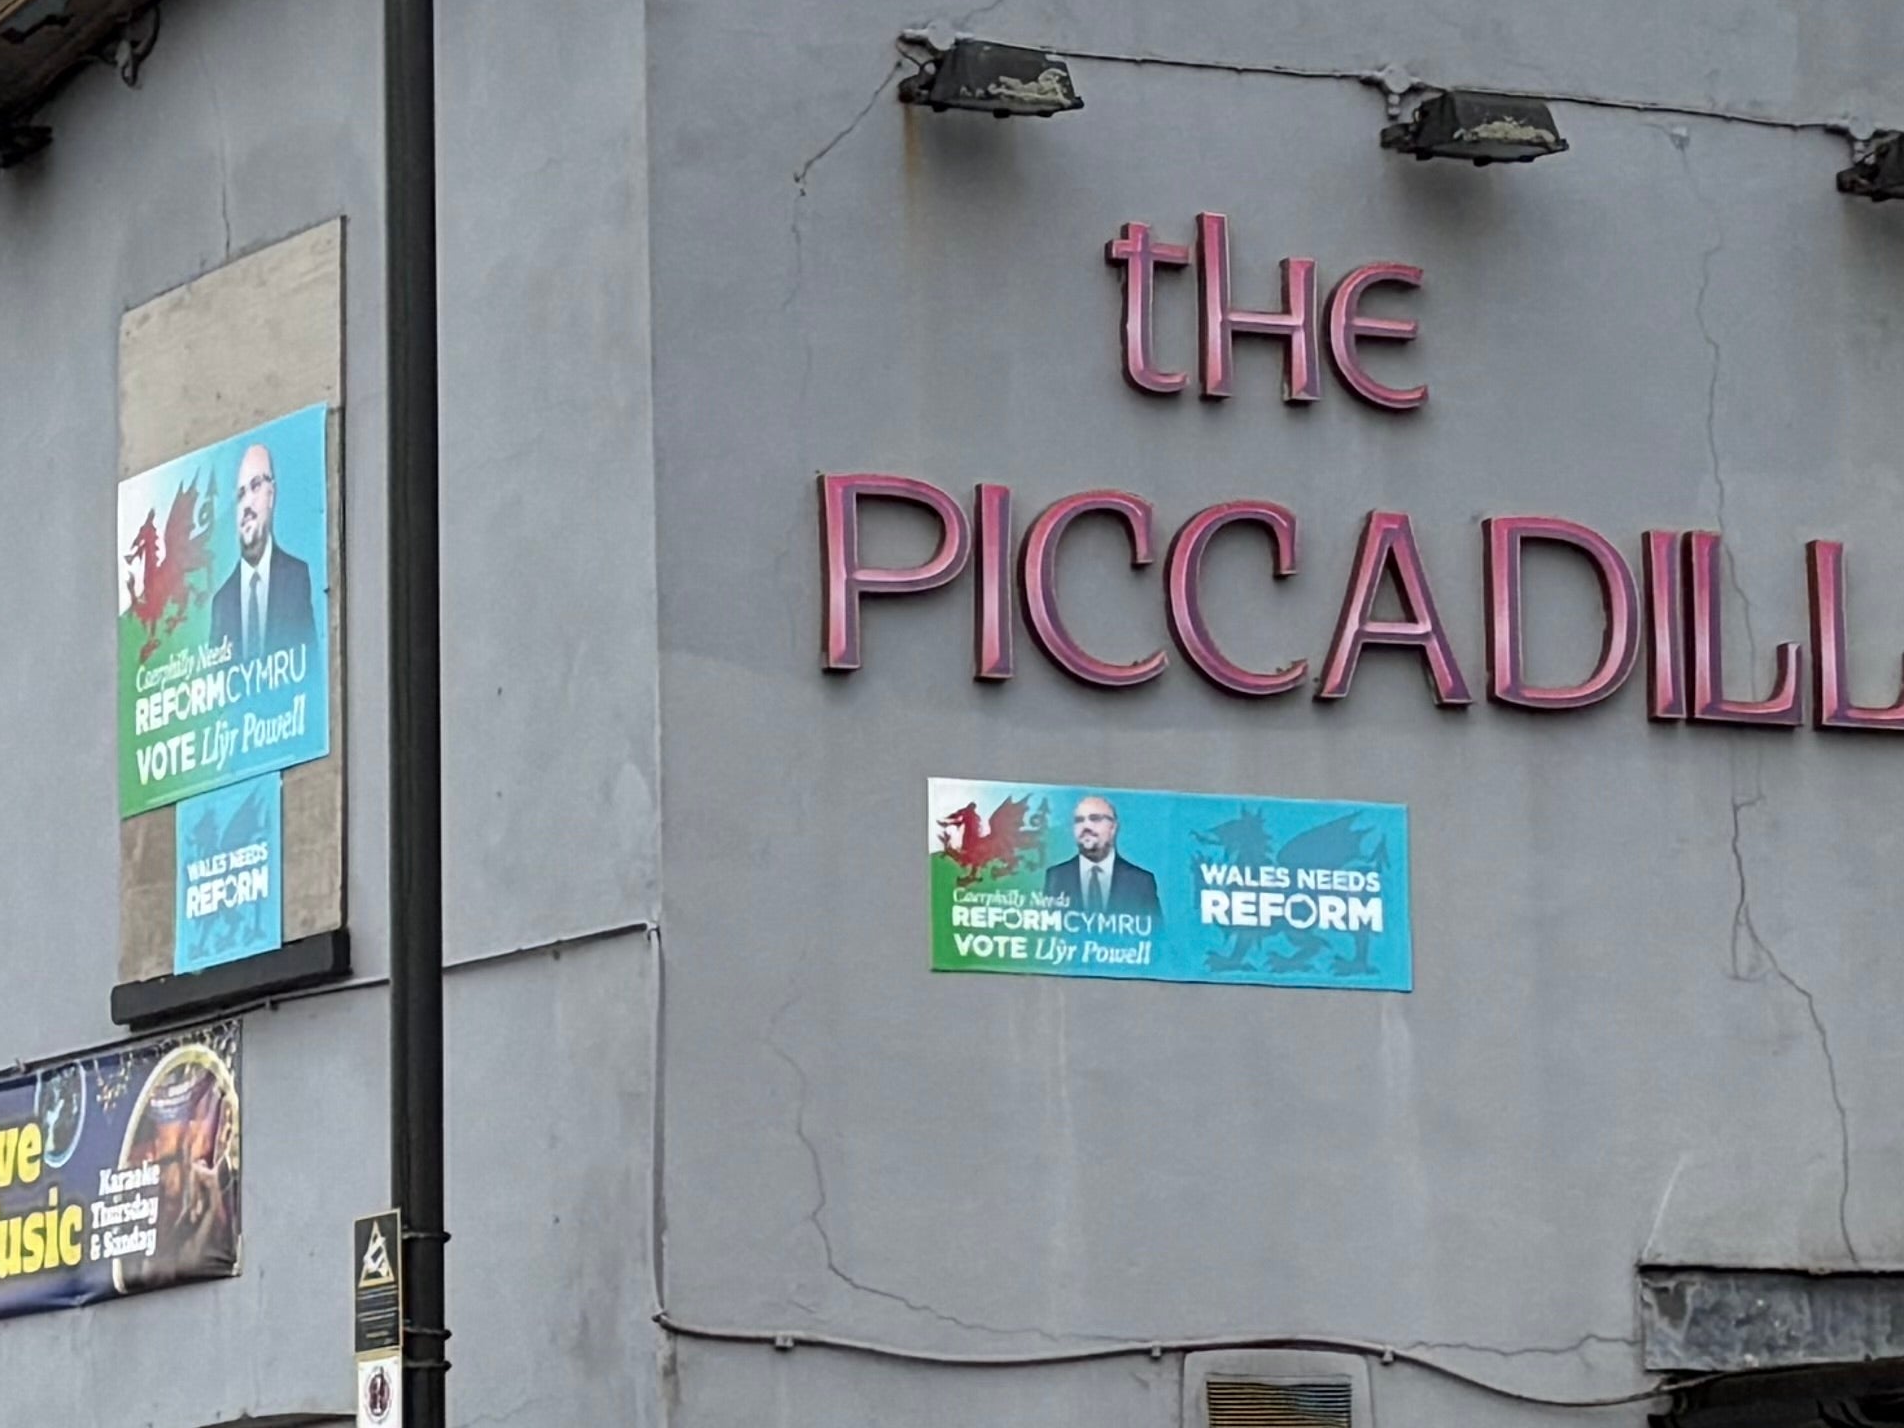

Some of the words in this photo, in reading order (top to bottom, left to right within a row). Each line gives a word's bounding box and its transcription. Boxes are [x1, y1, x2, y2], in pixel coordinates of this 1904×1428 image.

[197, 635, 233, 671] Needs
[136, 730, 195, 786] VOTE
[241, 693, 306, 753] Powell
[187, 853, 226, 882] WALES
[1200, 863, 1290, 889] WALES
[1297, 868, 1380, 893] NEEDS
[186, 865, 268, 919] REFORM
[1029, 891, 1071, 908] Needs
[1200, 889, 1383, 933] REFORM
[953, 933, 1029, 959] VOTE
[1081, 940, 1152, 964] Powell
[90, 1192, 159, 1229] Thursday
[103, 1225, 157, 1258] Sunday
